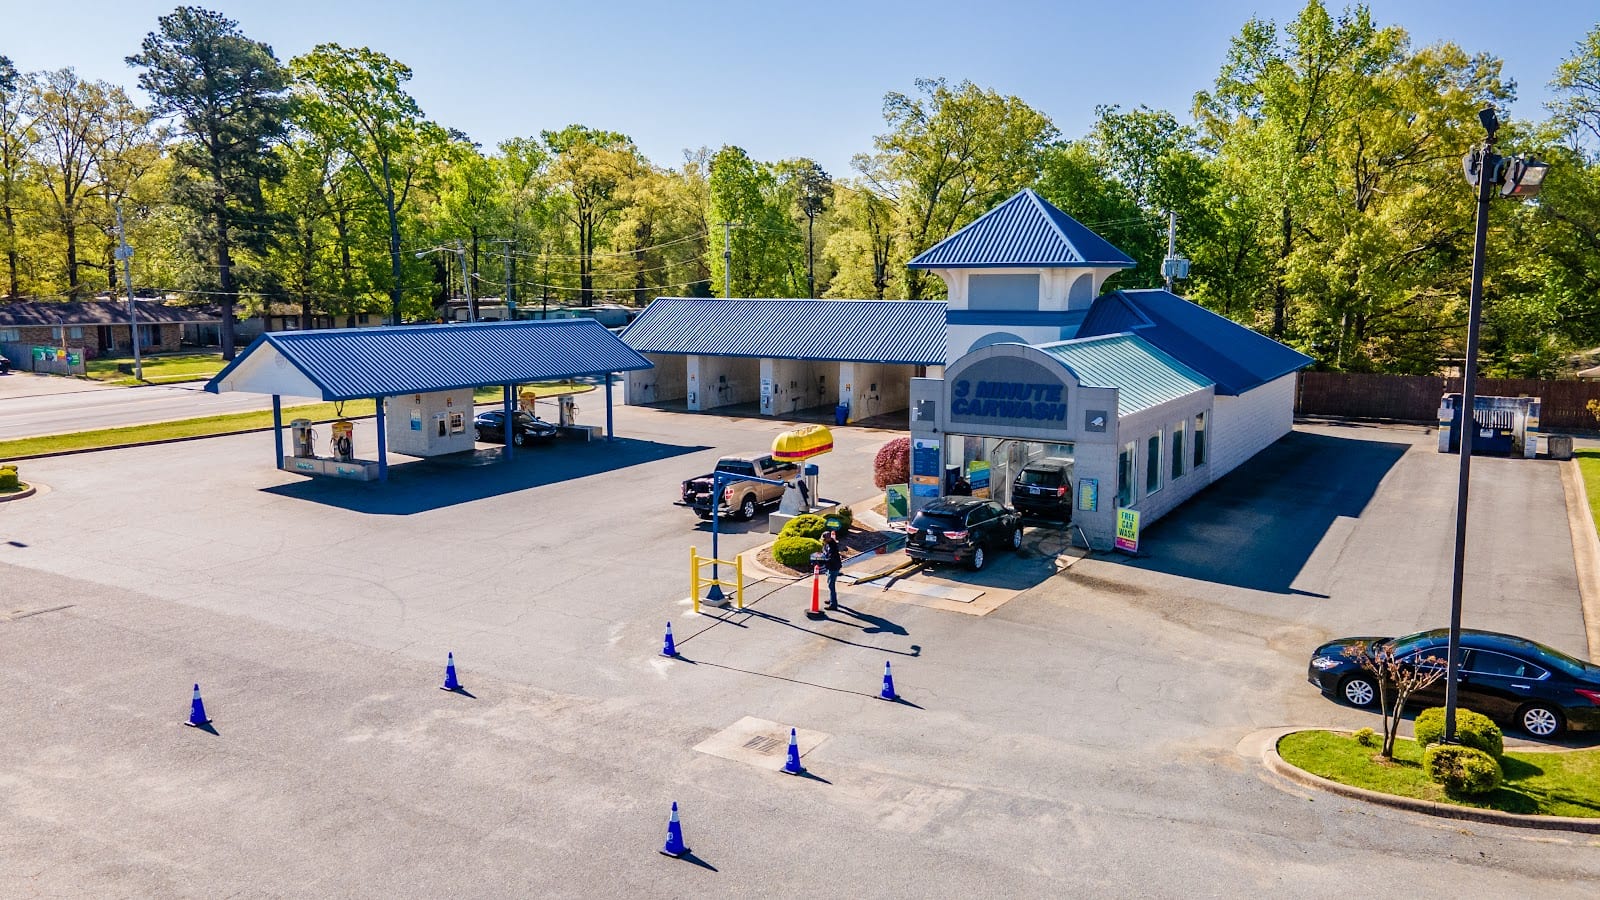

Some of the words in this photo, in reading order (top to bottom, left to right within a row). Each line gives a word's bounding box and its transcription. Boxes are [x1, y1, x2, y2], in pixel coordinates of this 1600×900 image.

[955, 380, 970, 397] 3
[976, 381, 1064, 402] MINUTE
[952, 399, 1067, 421] CARWASH
[1121, 512, 1135, 521] FREE
[1122, 520, 1133, 529] CAR
[1119, 528, 1135, 539] WASH
